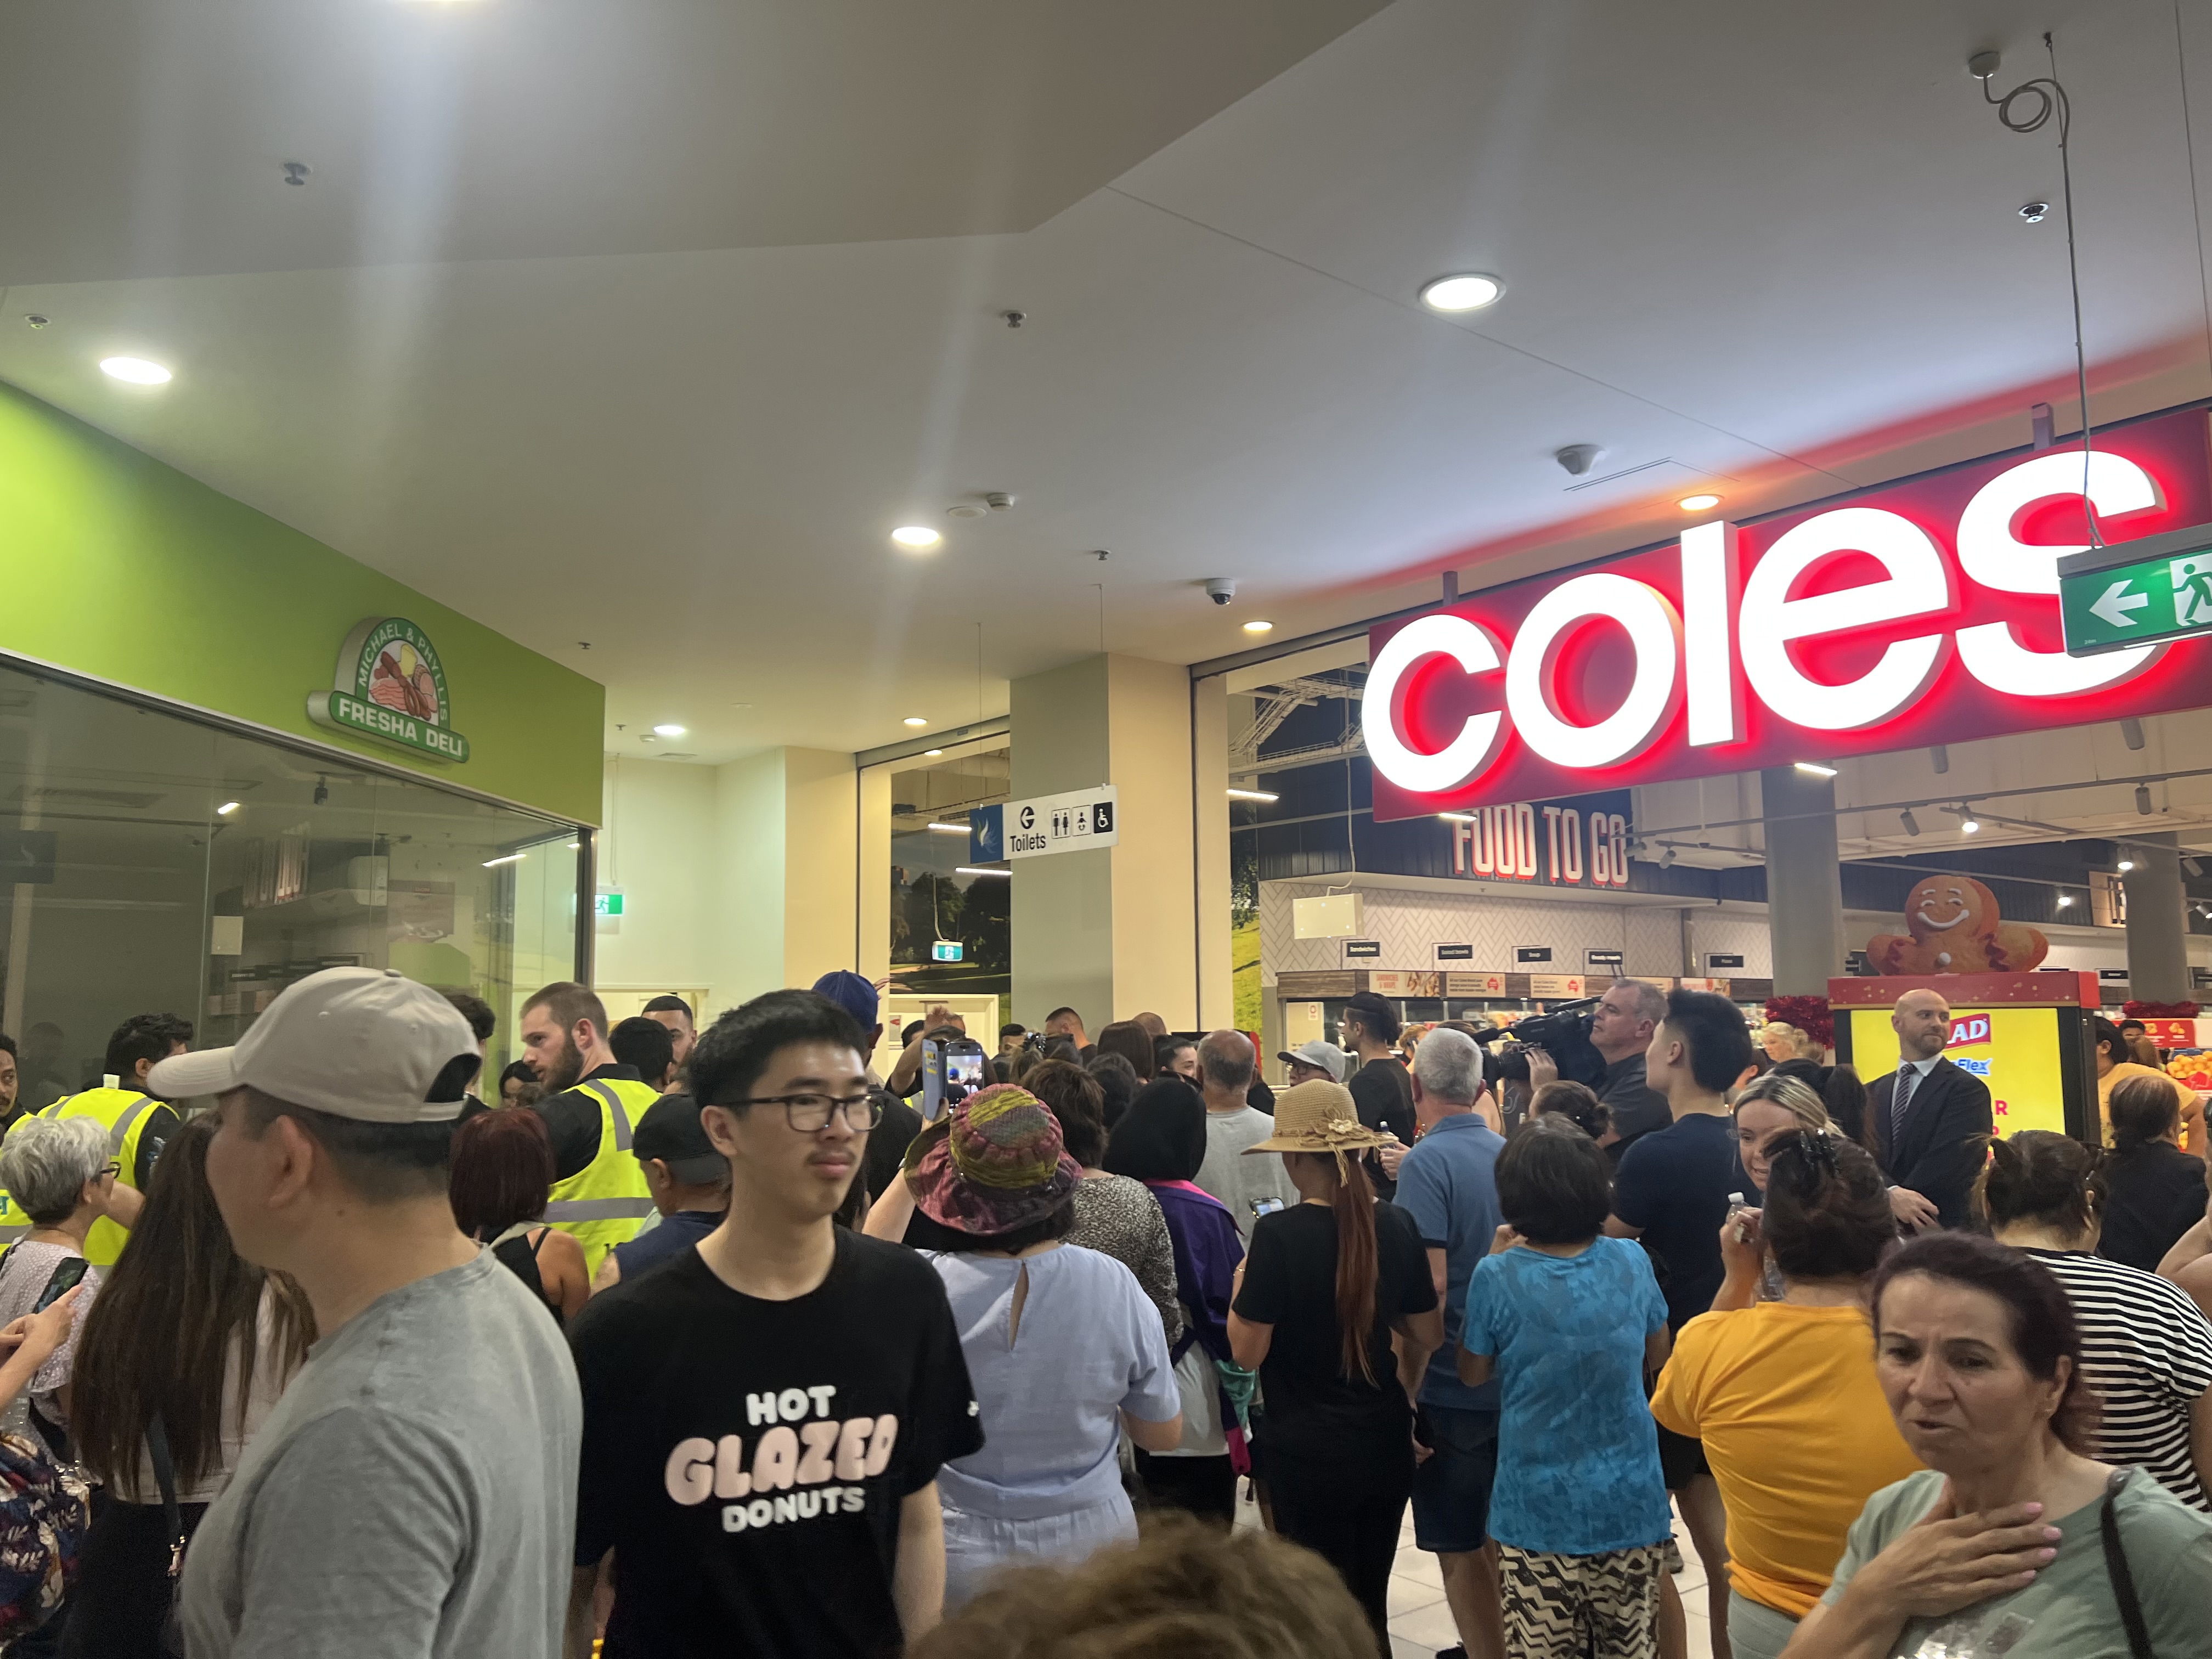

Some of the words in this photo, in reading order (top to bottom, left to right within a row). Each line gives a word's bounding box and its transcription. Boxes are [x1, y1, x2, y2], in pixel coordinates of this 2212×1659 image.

[1362, 450, 2163, 792] coles
[358, 623, 402, 687] MICHAEL
[406, 628, 414, 642] &
[339, 698, 417, 741] FRESHA
[426, 729, 462, 757] DELI
[1010, 833, 1046, 852] Toilets
[1453, 803, 1537, 880] FOOD
[1542, 806, 1583, 883] TO
[1590, 812, 1628, 887] GO
[1947, 1019, 1988, 1044] AD
[1951, 1058, 1993, 1071] Flex
[746, 1385, 836, 1425] HOT
[664, 1414, 898, 1505] GLAZED
[722, 1487, 865, 1532] DONUTS
